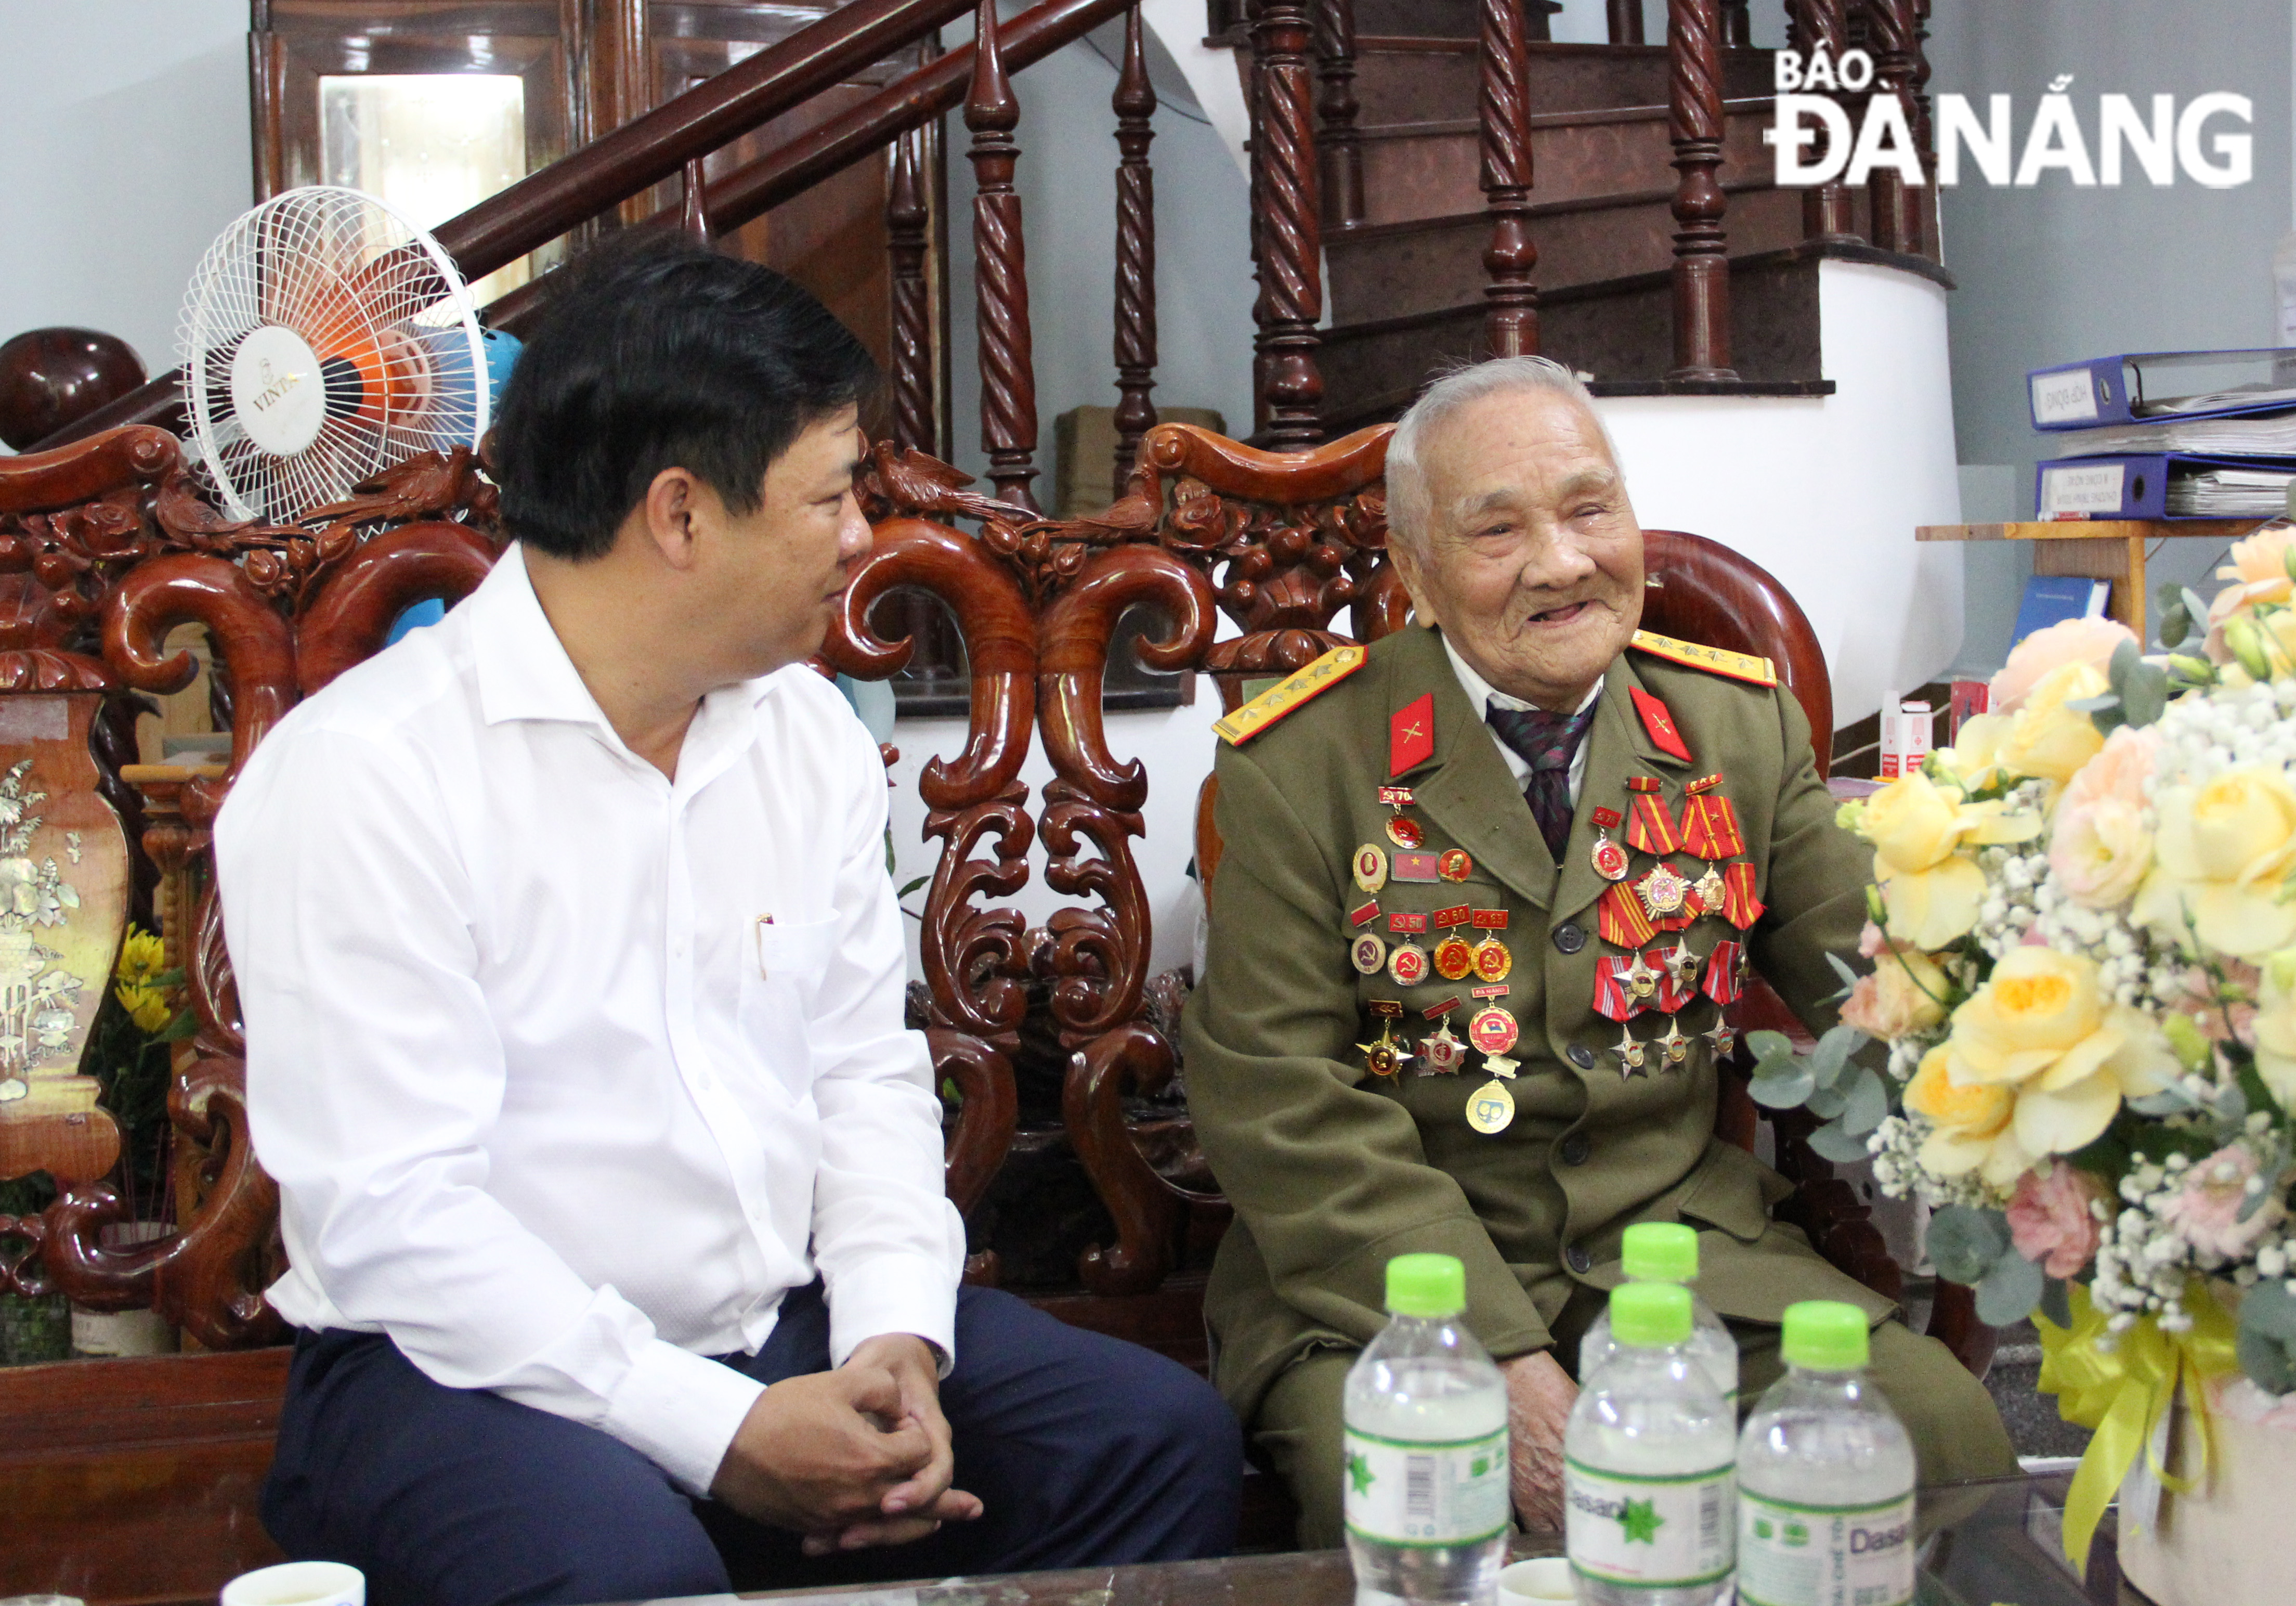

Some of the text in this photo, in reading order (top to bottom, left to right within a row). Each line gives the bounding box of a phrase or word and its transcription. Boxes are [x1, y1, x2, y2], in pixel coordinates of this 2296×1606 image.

[1397, 791, 1411, 801] 70
[1452, 909, 1466, 921] 60
[1408, 917, 1423, 929] 50
